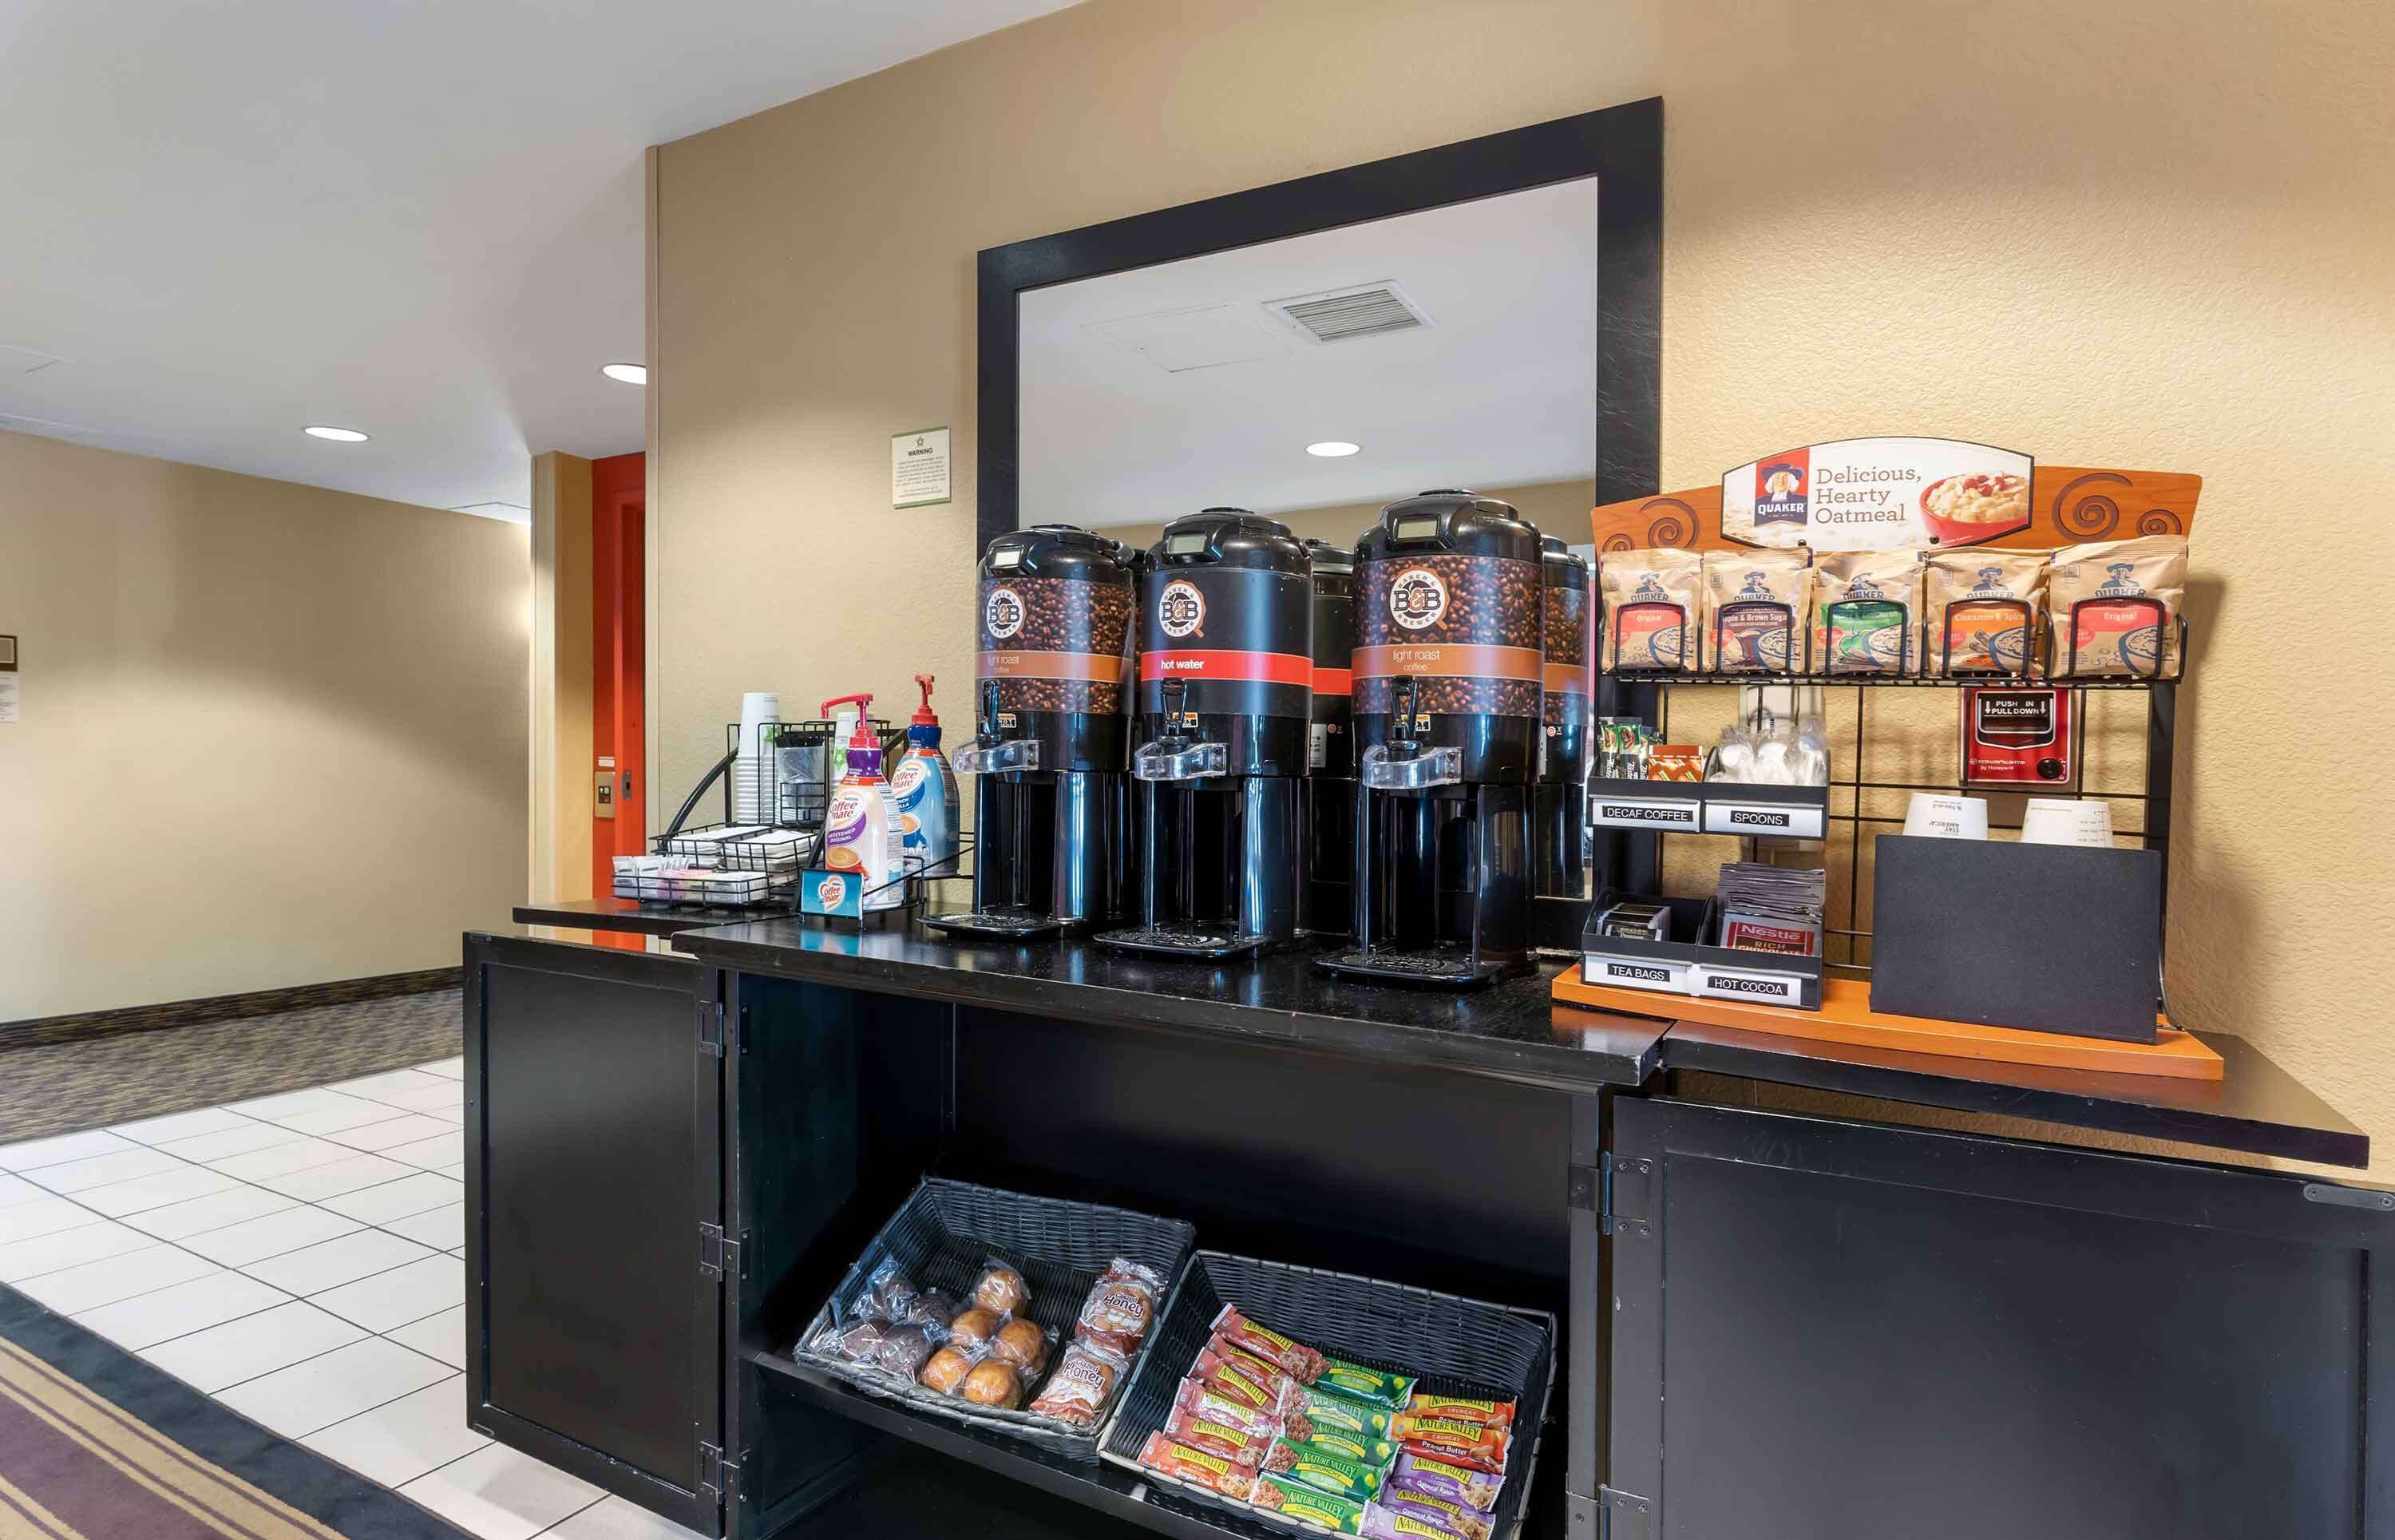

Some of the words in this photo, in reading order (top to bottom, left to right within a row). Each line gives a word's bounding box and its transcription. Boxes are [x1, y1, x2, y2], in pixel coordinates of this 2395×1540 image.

[908, 447, 932, 457] WARNING
[1816, 466, 1922, 485] Delicious,
[1815, 488, 1890, 505] Hearty
[1758, 503, 1804, 515] QUAKER
[1815, 504, 1906, 524] Oatmeal
[2095, 588, 2146, 597] QUAKER
[1724, 614, 1739, 623] aple
[1769, 613, 1787, 622] Suga
[2104, 612, 2137, 621] Original
[1000, 655, 1019, 664] roast
[1392, 649, 1412, 663] light
[1415, 650, 1440, 660] roast
[1161, 659, 1175, 670] hot
[1176, 659, 1205, 670] water
[1403, 663, 1427, 671] coffee
[830, 798, 857, 814] Coffee
[832, 810, 853, 820] mate
[1607, 808, 1642, 819] DECAF
[1645, 810, 1688, 821] COFFEE
[1734, 813, 1783, 825] SPOONS
[821, 884, 841, 897] Coffee
[1612, 966, 1633, 976] TEA
[1635, 968, 1665, 980] BAGS
[1715, 978, 1738, 989] HOT
[1740, 981, 1783, 994] COCOA
[1104, 1295, 1143, 1317] Honey
[1076, 1359, 1099, 1372] Glazed
[1334, 1360, 1362, 1371] NATURE
[1063, 1362, 1103, 1388] Honey
[1218, 1368, 1244, 1388] NATURE
[1245, 1383, 1268, 1406] VALLEY
[1195, 1420, 1223, 1435] NATURE
[1223, 1426, 1249, 1448] VALLEY
[1316, 1423, 1343, 1435] NATURE
[1343, 1429, 1368, 1448] VALLEY
[1417, 1417, 1450, 1431] NATURE
[1450, 1421, 1480, 1440] VALLEY
[1325, 1435, 1355, 1448] CRUNCHY
[1432, 1433, 1461, 1443] CRUNCHY
[1422, 1440, 1444, 1451] Peanut
[1446, 1446, 1467, 1455] Butter
[1174, 1445, 1201, 1462] NATURE
[1201, 1451, 1230, 1475] VALLEY
[1302, 1453, 1331, 1467] NATURE
[1331, 1460, 1356, 1478] VALLEY
[1309, 1463, 1342, 1478] CRUNCHY
[1415, 1458, 1444, 1472] NATURE
[1443, 1463, 1471, 1483] VALLEY
[1417, 1480, 1439, 1491] Oatmeal
[1439, 1487, 1455, 1496] Raisin
[1288, 1491, 1317, 1506] NATURE
[1317, 1499, 1344, 1518] VALLEY
[1296, 1505, 1328, 1518] CRUNCHY
[1403, 1507, 1426, 1519] Oatmeal
[1398, 1517, 1431, 1533] NATURE
